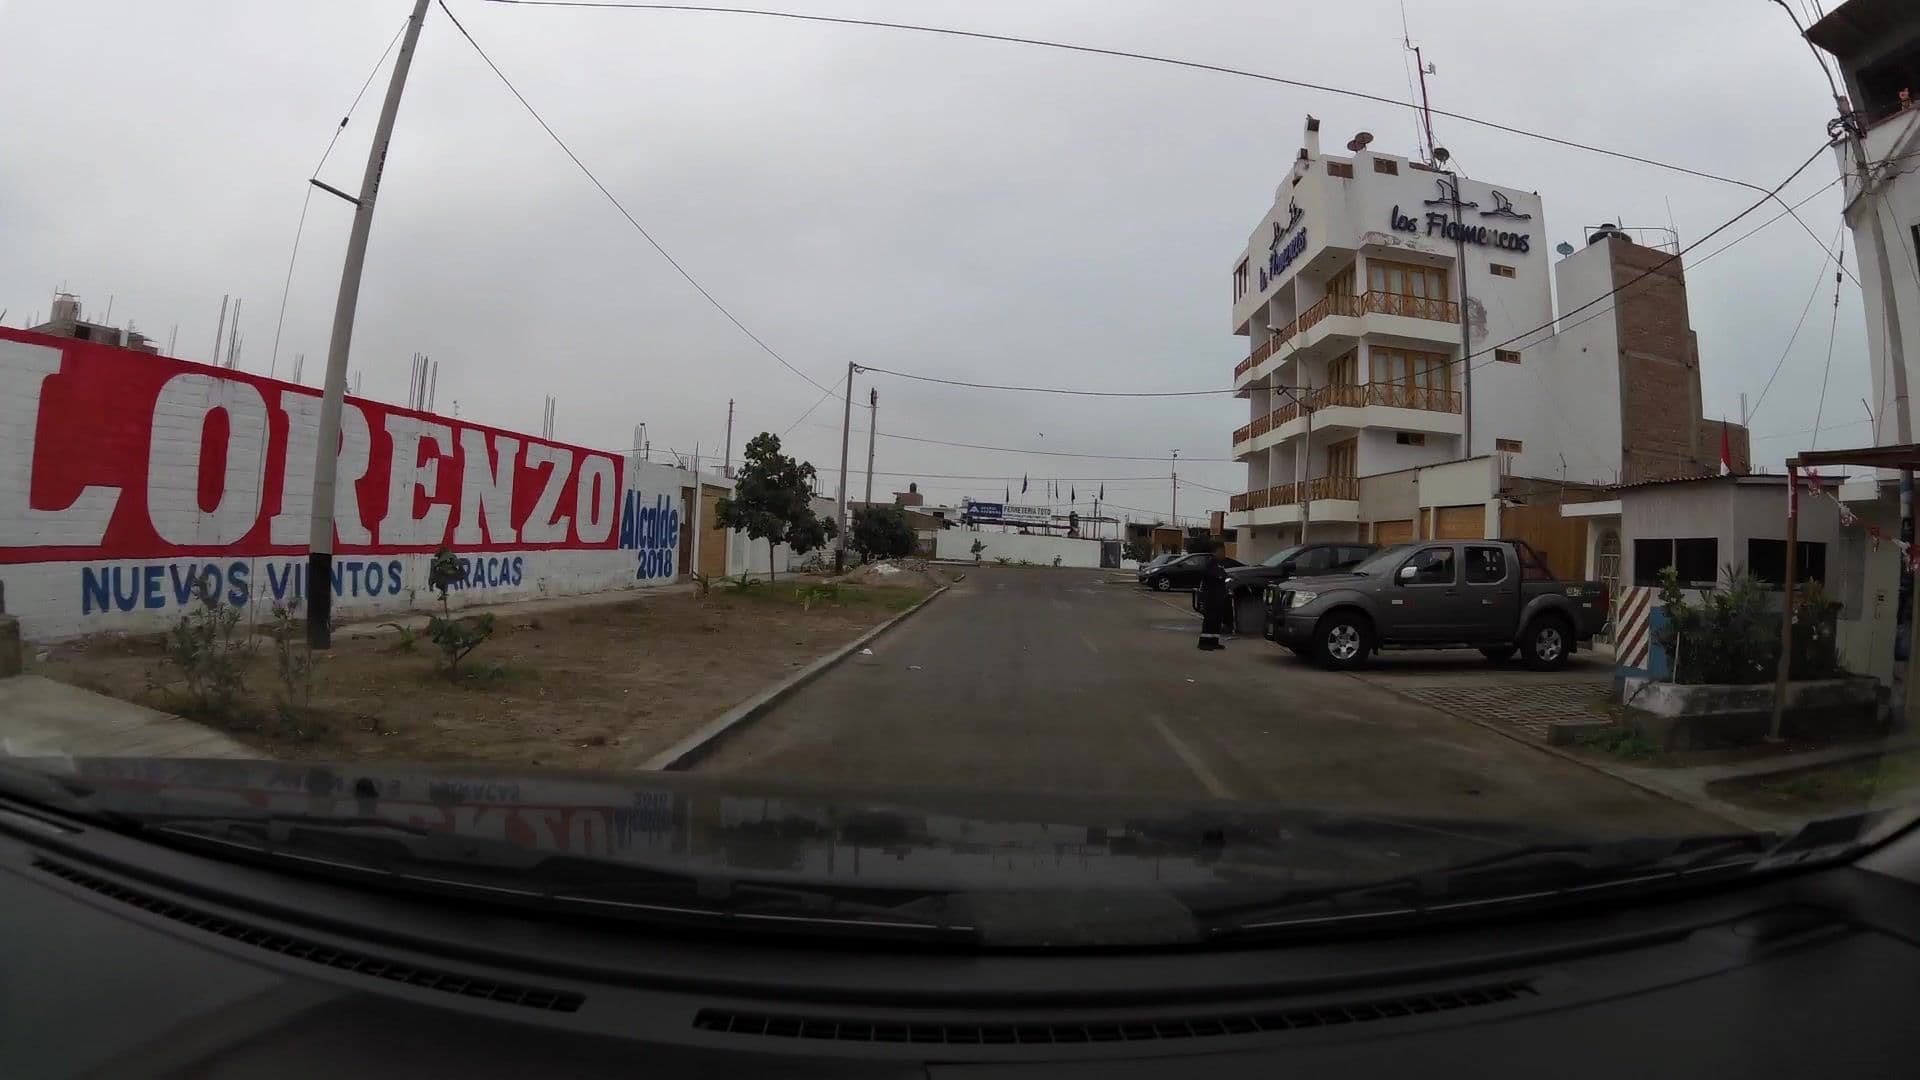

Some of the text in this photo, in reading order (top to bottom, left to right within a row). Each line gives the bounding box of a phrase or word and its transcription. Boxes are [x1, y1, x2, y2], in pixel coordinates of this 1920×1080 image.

[0, 337, 616, 547] LORENZO
[619, 488, 679, 550] Alcalde
[82, 560, 249, 615] NUEVOS
[266, 559, 403, 601] VINTOS
[636, 549, 673, 580] 2018
